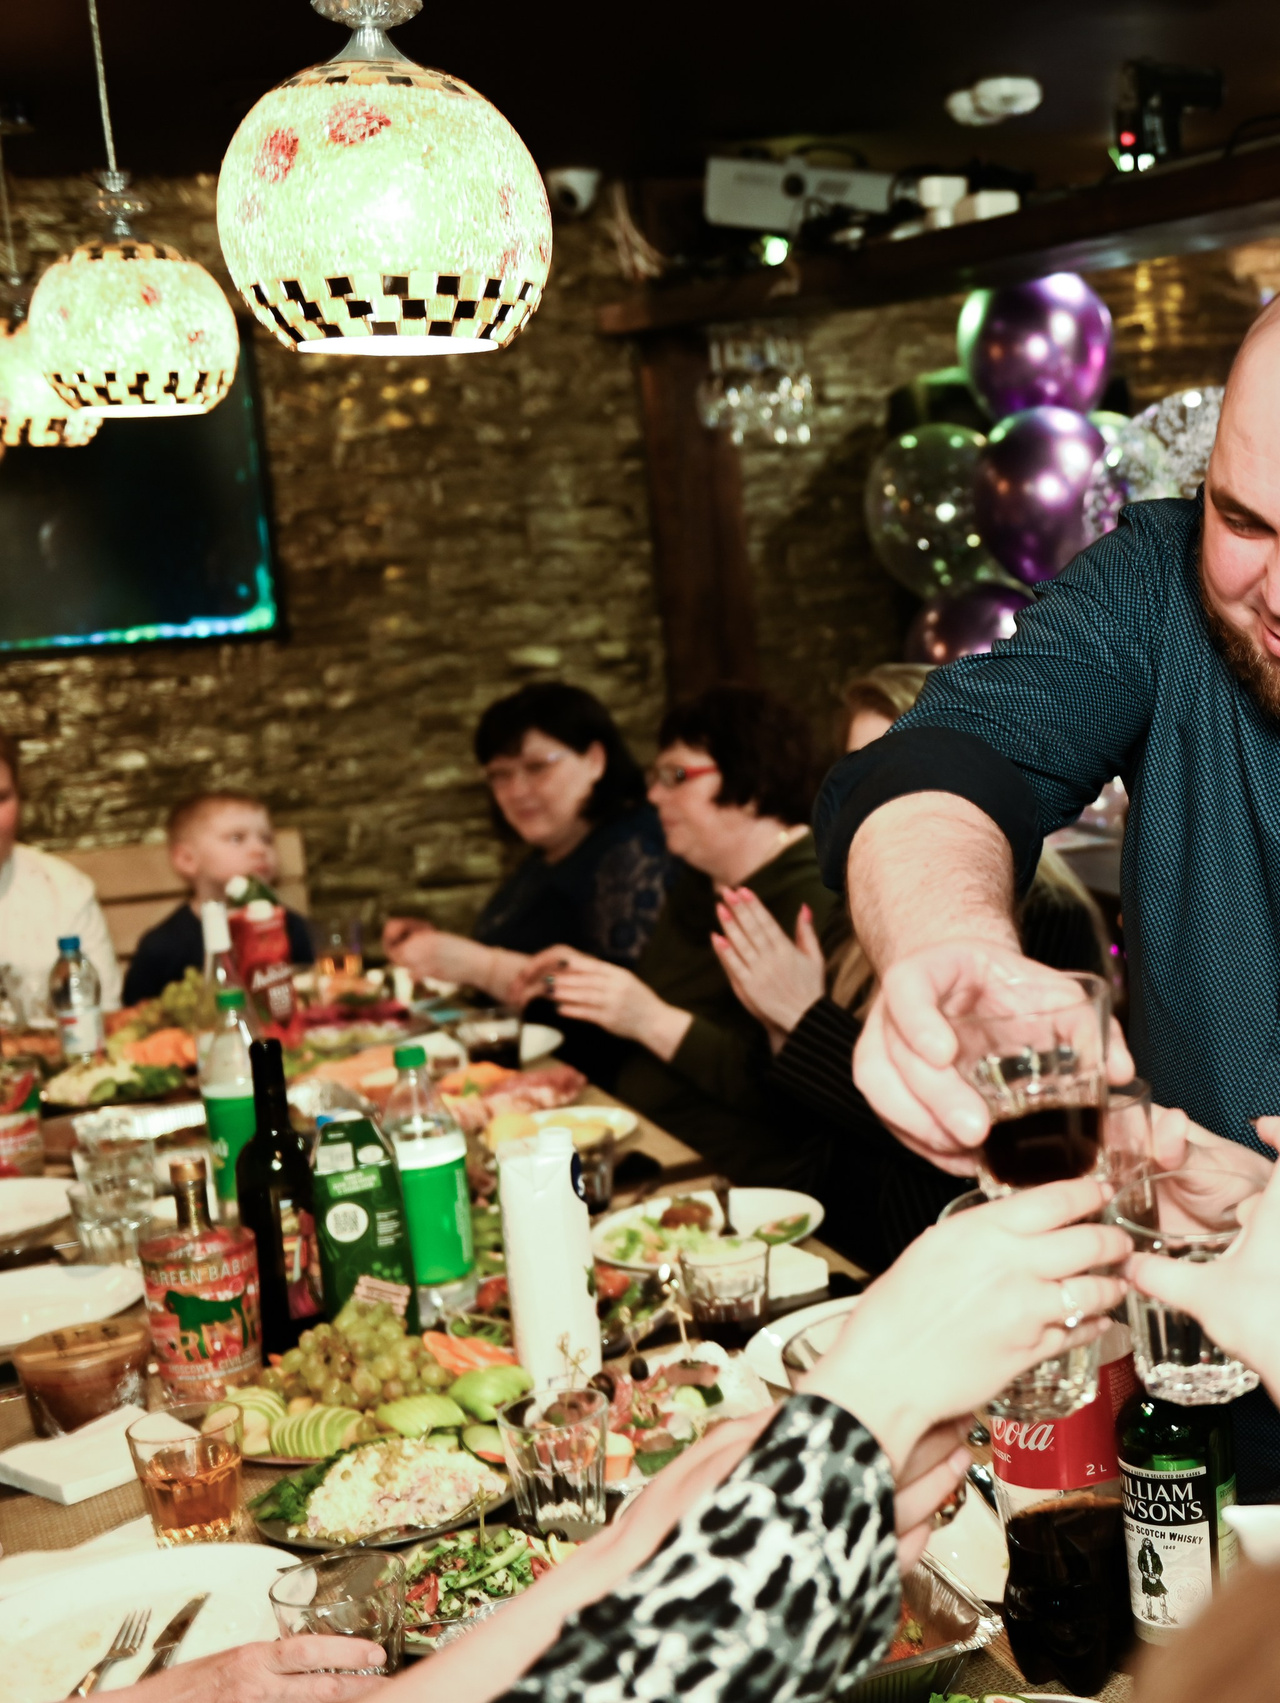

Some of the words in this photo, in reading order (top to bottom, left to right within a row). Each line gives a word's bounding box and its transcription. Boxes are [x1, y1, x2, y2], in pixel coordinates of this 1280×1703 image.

[1086, 1463, 1096, 1476] 2
[1100, 1464, 1107, 1473] L
[1136, 1525, 1166, 1540] SCOTCH
[1169, 1532, 1203, 1545] WHISKY
